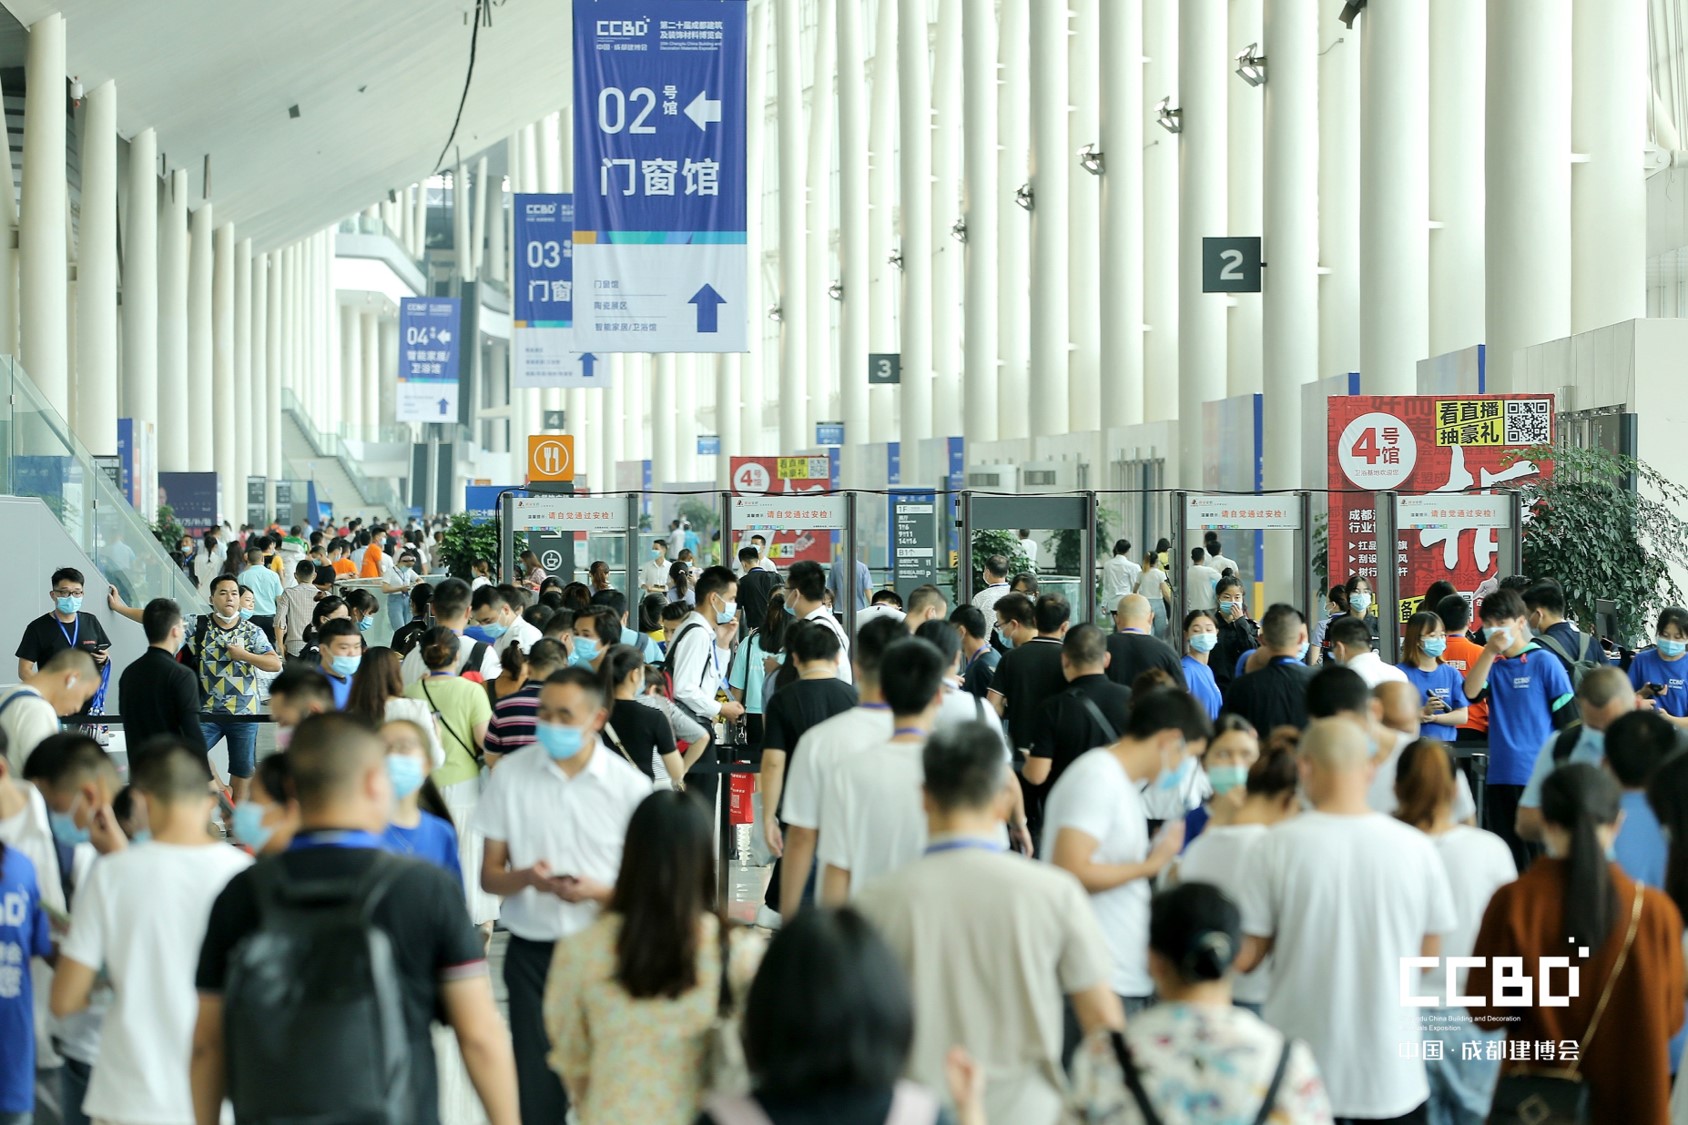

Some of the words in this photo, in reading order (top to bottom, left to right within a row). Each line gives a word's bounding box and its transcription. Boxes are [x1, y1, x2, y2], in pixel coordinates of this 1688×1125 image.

[597, 20, 648, 36] CCBD
[598, 87, 656, 134] 02
[662, 85, 678, 116] 号馆
[601, 158, 719, 196] 门窗馆
[527, 241, 560, 268] 03
[1220, 249, 1244, 280] 2
[407, 326, 429, 345] 04
[877, 359, 892, 378] 3
[1440, 401, 1499, 425] 看直播
[1352, 427, 1380, 464] 4
[1382, 427, 1400, 464] 号馆
[1440, 421, 1499, 445] 抽豪礼
[741, 470, 753, 486] 4
[1349, 521, 1376, 533] 行业
